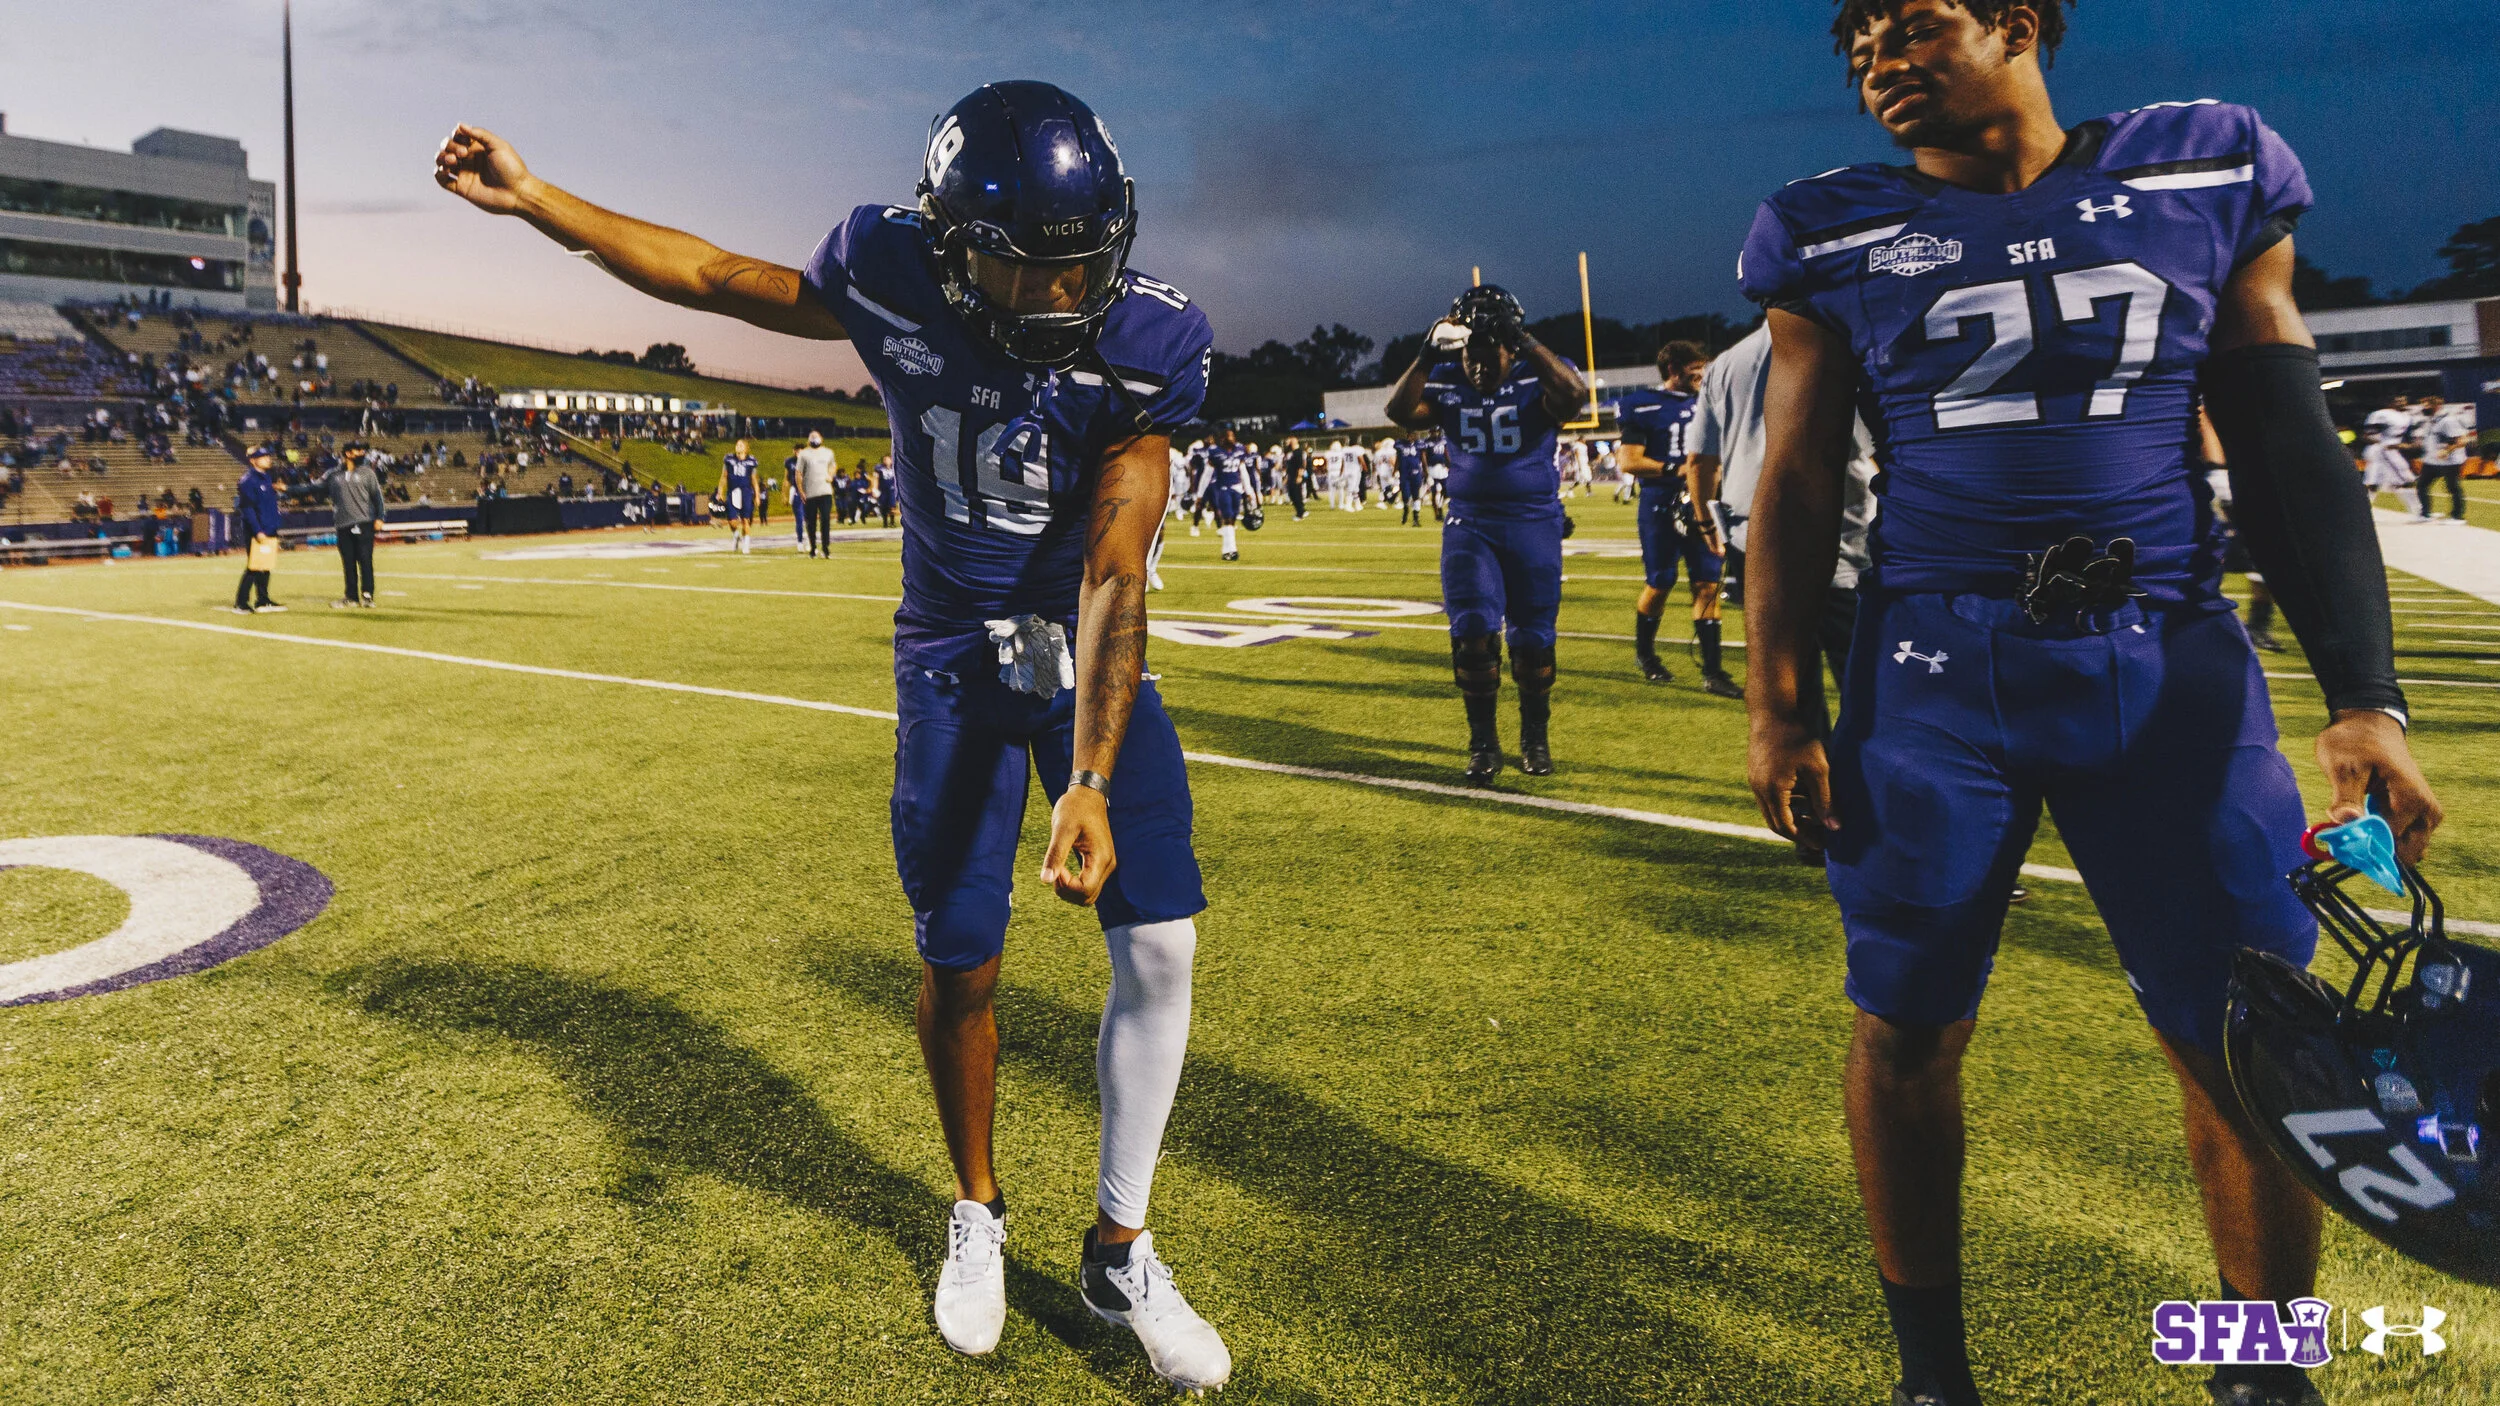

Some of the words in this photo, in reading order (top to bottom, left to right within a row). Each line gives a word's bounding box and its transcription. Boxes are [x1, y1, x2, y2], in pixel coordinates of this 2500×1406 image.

[1043, 221, 1085, 236] VICIS
[1872, 239, 1960, 271] SOUTHLAND
[2006, 238, 2057, 265] SFA
[1130, 276, 1189, 311] 19
[885, 338, 942, 374] SOUTHLAND
[1923, 261, 2169, 430] 27
[970, 384, 1001, 410] SFA
[1460, 405, 1521, 454] 56
[919, 404, 1055, 535] 19
[2281, 1108, 2456, 1222] 27
